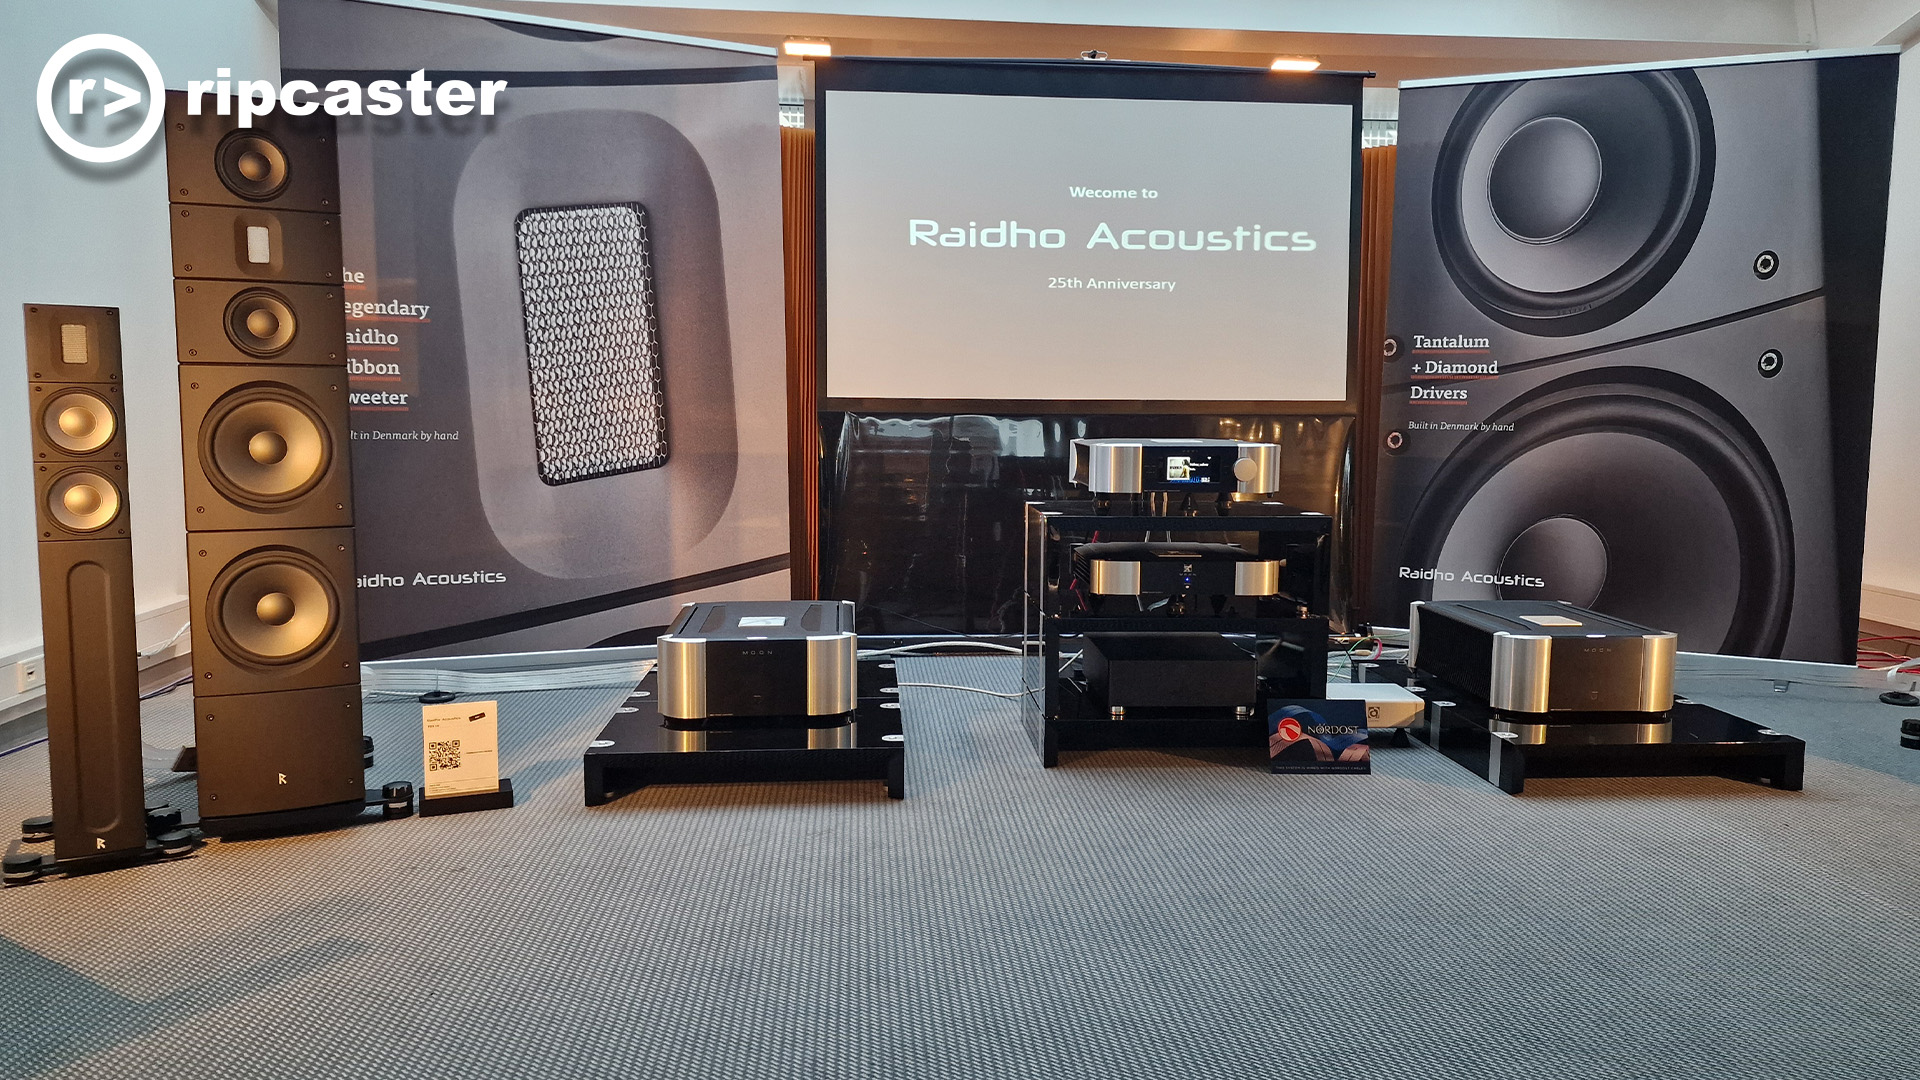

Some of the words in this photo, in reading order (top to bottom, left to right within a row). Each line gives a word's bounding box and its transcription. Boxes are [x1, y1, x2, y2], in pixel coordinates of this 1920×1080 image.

[1069, 185, 1138, 199] Wecome
[1141, 187, 1159, 200] to
[908, 218, 1067, 249] Raidho
[1086, 222, 1318, 252] Acoustics
[343, 266, 366, 283] he
[1047, 276, 1083, 290] 25th
[1086, 277, 1177, 293] Anniversary
[344, 299, 430, 319] egendary
[345, 328, 399, 346] aidho
[1413, 335, 1490, 349] Tantalum
[346, 358, 401, 375] ibbon
[1424, 360, 1499, 374] Diamond
[348, 391, 409, 405] weeter
[1409, 386, 1468, 399] Drivers
[1408, 420, 1429, 430] Built
[1429, 421, 1438, 430] in
[1440, 421, 1479, 431] Denmark
[1480, 422, 1491, 433] by
[1492, 422, 1515, 432] hand
[359, 430, 370, 440] in
[372, 430, 419, 440] Denmark
[420, 430, 433, 442] by
[433, 430, 459, 440] hand
[356, 573, 405, 588] aidho
[412, 570, 507, 586] Acoustics
[1398, 566, 1455, 582] Raidho
[1461, 570, 1545, 588] Acoustics
